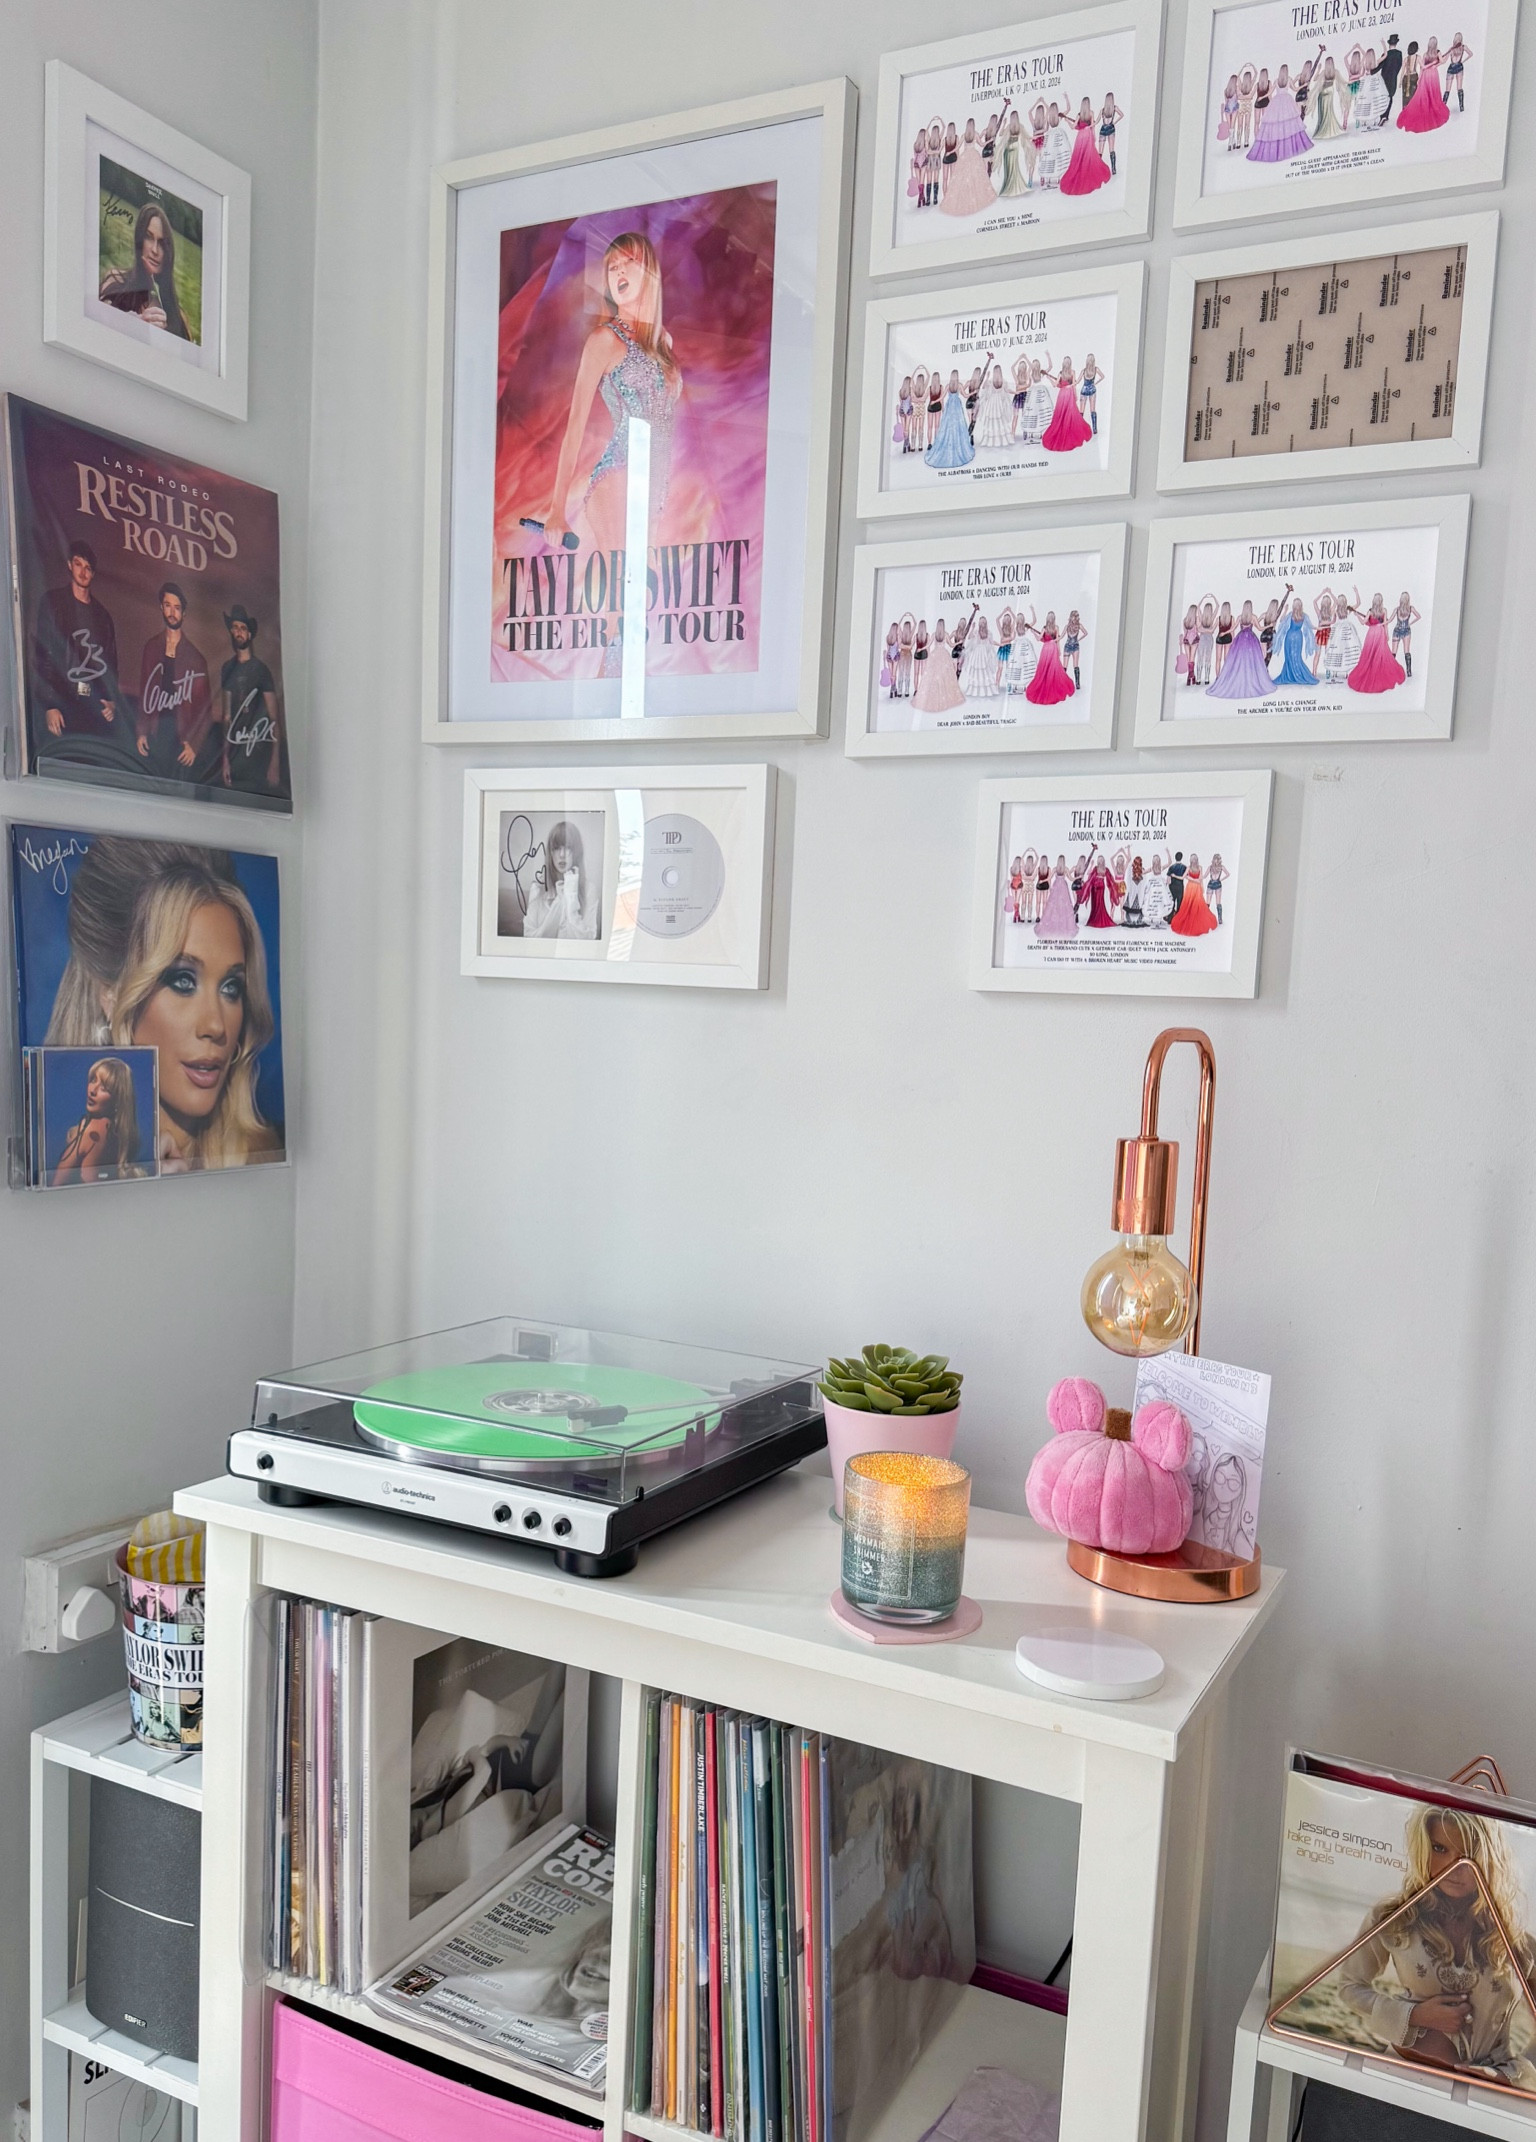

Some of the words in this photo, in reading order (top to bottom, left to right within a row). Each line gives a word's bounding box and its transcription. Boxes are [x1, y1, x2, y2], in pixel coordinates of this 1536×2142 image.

[1292, 4, 1318, 27] THE
[1324, 0, 1359, 21] ERAS
[1328, 23, 1338, 34] UK
[1348, 18, 1367, 32] JUNE
[1379, 12, 1395, 24] 2024
[970, 68, 993, 90] THE
[997, 61, 1027, 84] ERAS
[1032, 53, 1063, 77] TOUR
[1005, 86, 1014, 96] UK
[1023, 81, 1038, 94] JUNE
[1048, 76, 1061, 88] 2024
[1380, 274, 1389, 307] Reminder
[1442, 266, 1452, 299] Reminder
[1260, 290, 1269, 322] Reminder
[1319, 282, 1328, 314] Reminder
[954, 320, 977, 340] THE
[981, 316, 1010, 337] ERAS
[1015, 311, 1046, 332] TOUR
[1202, 299, 1210, 329] Reminder
[976, 339, 1001, 351] IRELAND
[1009, 335, 1024, 348] JUNE
[1035, 333, 1048, 343] 2024
[1344, 337, 1353, 369] Reminder
[1406, 329, 1414, 362] Reminder
[1226, 351, 1235, 382] Reminder
[1284, 344, 1293, 375] Reminder
[1310, 398, 1319, 429] Reminder
[1370, 391, 1379, 423] Reminder
[1433, 385, 1441, 417] Reminder
[1194, 410, 1202, 441] Reminder
[1252, 404, 1260, 435] Reminder
[103, 456, 145, 477] LAST
[157, 475, 210, 502] RODEO
[73, 461, 238, 559] RESTLESS
[123, 518, 207, 572] ROAD
[1249, 544, 1275, 565] THE
[1279, 541, 1314, 563] ERAS
[1319, 539, 1355, 560] TOUR
[941, 569, 963, 588] THE
[967, 566, 996, 586] ERAS
[1001, 563, 1031, 583] TOUR
[1278, 566, 1288, 577] UK
[1298, 564, 1327, 576] AUGUST
[1338, 562, 1354, 573] 2024
[966, 589, 975, 599] UK
[983, 587, 1007, 598] AUGUST
[1017, 585, 1030, 595] 2024
[503, 620, 562, 652] THE
[658, 609, 746, 645] TOUR
[1071, 810, 1095, 828] THE
[1099, 809, 1130, 828] ERAS
[1135, 808, 1167, 827] TOUR
[1096, 831, 1106, 841] UK
[1115, 831, 1141, 841] AUGUST
[1153, 830, 1167, 840] 2024
[1172, 1355, 1195, 1367] THE
[1197, 1358, 1224, 1374] ERAS
[1224, 1365, 1253, 1381] TOUR
[1200, 1371, 1240, 1389] LONDON
[1193, 1392, 1209, 1410] TO
[853, 1545, 886, 1563] SHIMMER
[854, 1532, 887, 1550] MERMAID
[139, 1664, 171, 1682] ERAS
[696, 1752, 705, 1781] JUSTIN
[697, 1782, 705, 1832] TIMBERLAKE
[1287, 1829, 1312, 1845] take
[1314, 1838, 1332, 1853] my
[1335, 1842, 1372, 1861] breath
[1374, 1854, 1408, 1873] away
[1296, 1846, 1335, 1865] angels
[1342, 1832, 1392, 1852] simpson
[507, 1891, 563, 1921] SWIFT
[520, 1881, 581, 1915] TAYLOR
[484, 1912, 502, 1925] JONI
[502, 1920, 533, 1937] MITCHELL
[491, 1907, 505, 1918] THE
[519, 1919, 552, 1936] CENTURY
[497, 1902, 515, 1915] HOW
[515, 1909, 527, 1920] SHE
[527, 1916, 556, 1931] BECAME
[446, 1942, 470, 1957] ALBUMS
[471, 1954, 494, 1968] VALUED
[451, 1937, 466, 1947] HER
[465, 1943, 504, 1965] COLLECTABLE
[125, 2013, 147, 2028] EDIFIER
[451, 2012, 487, 2030] BURNETTE
[517, 2018, 534, 2028] WAR
[499, 2032, 525, 2045] YOUTH
